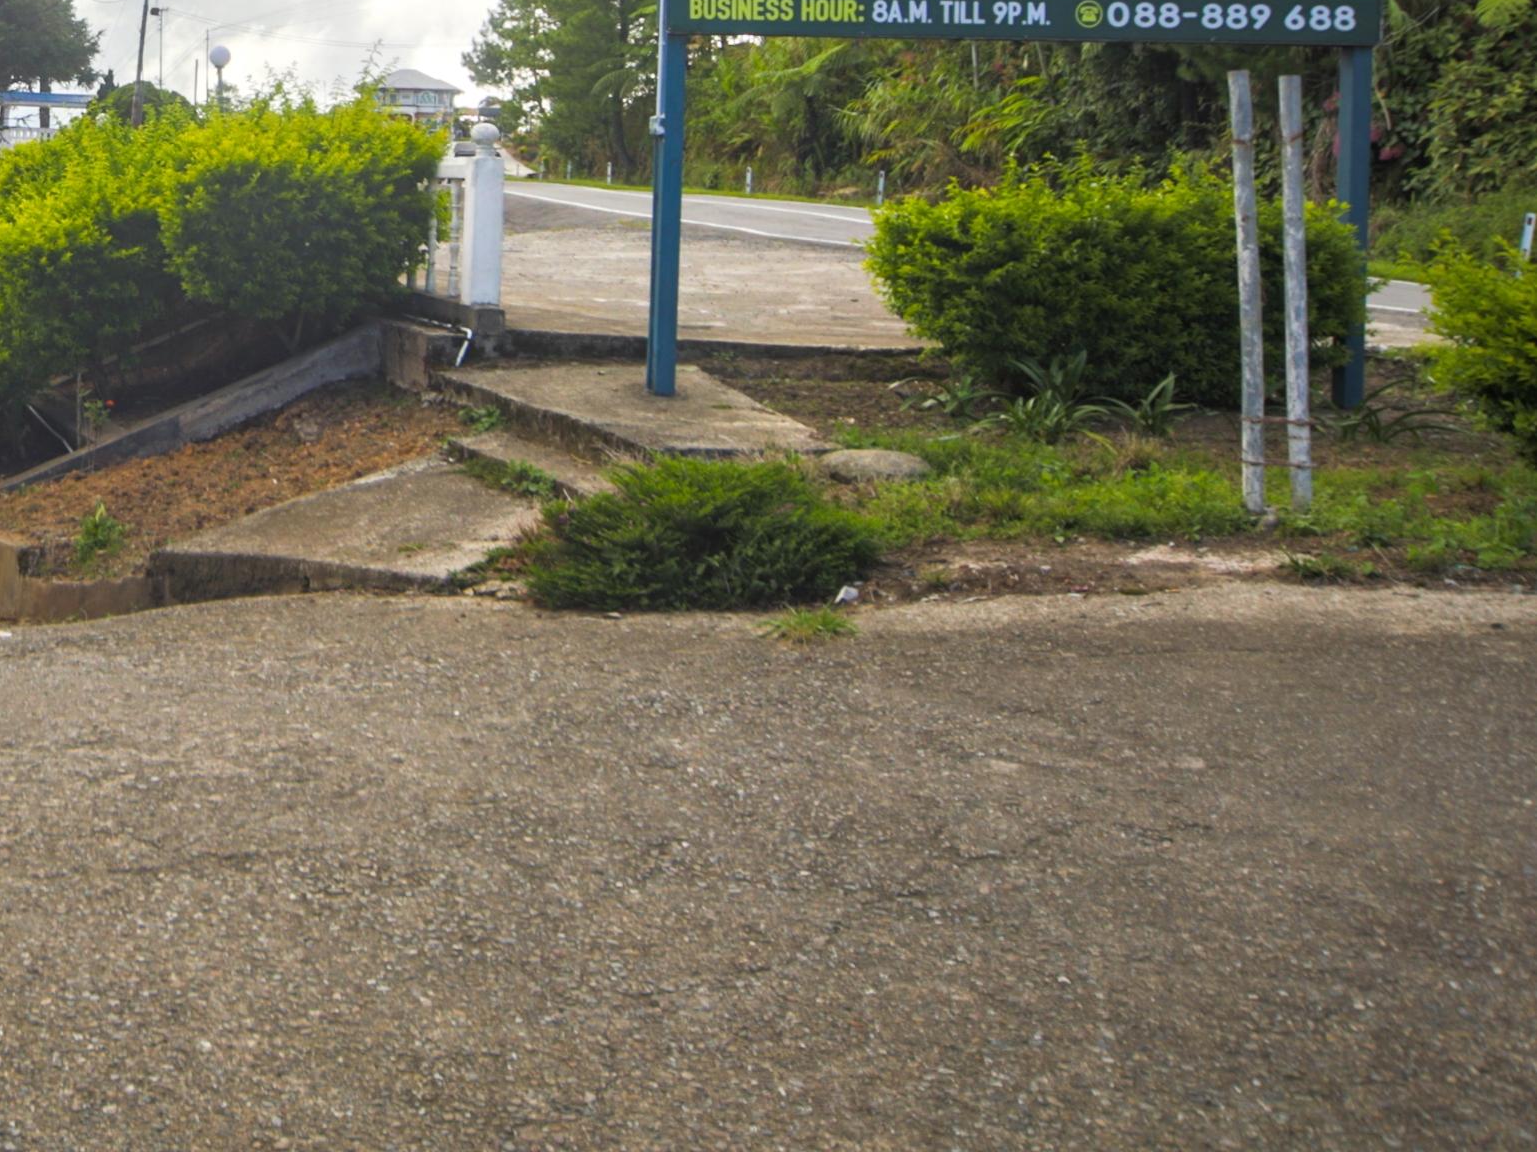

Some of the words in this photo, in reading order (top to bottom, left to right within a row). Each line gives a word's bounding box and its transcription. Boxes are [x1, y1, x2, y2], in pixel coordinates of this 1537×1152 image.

[872, 0, 932, 24] 8A.M.
[940, 0, 985, 25] TILL
[992, 1, 1051, 26] 9P.M.
[1106, 2, 1271, 30] 088-889
[1284, 4, 1356, 31] 688
